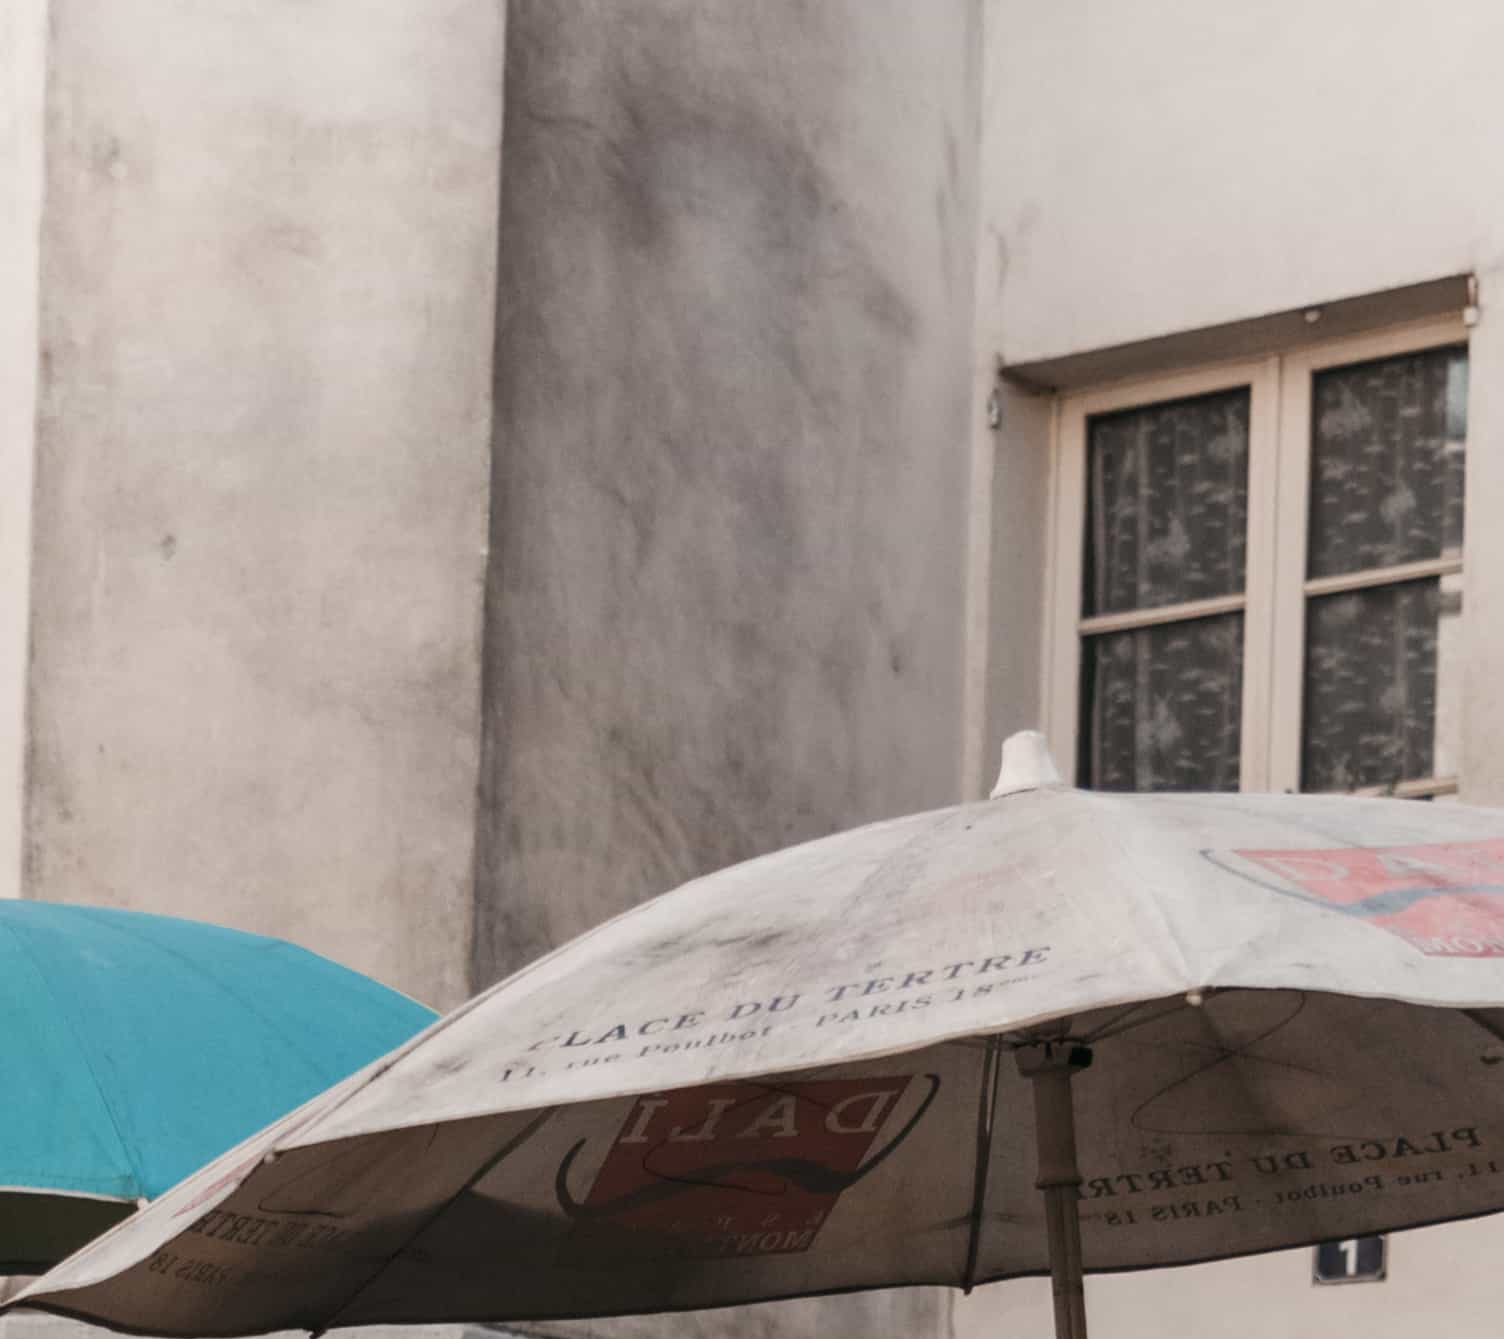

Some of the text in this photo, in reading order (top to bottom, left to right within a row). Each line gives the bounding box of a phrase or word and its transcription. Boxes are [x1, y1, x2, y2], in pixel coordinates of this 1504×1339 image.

[727, 993, 801, 1022] DU
[826, 945, 1052, 1002] TERTRE
[816, 994, 932, 1029] PARIS
[1338, 1238, 1360, 1276] 1
